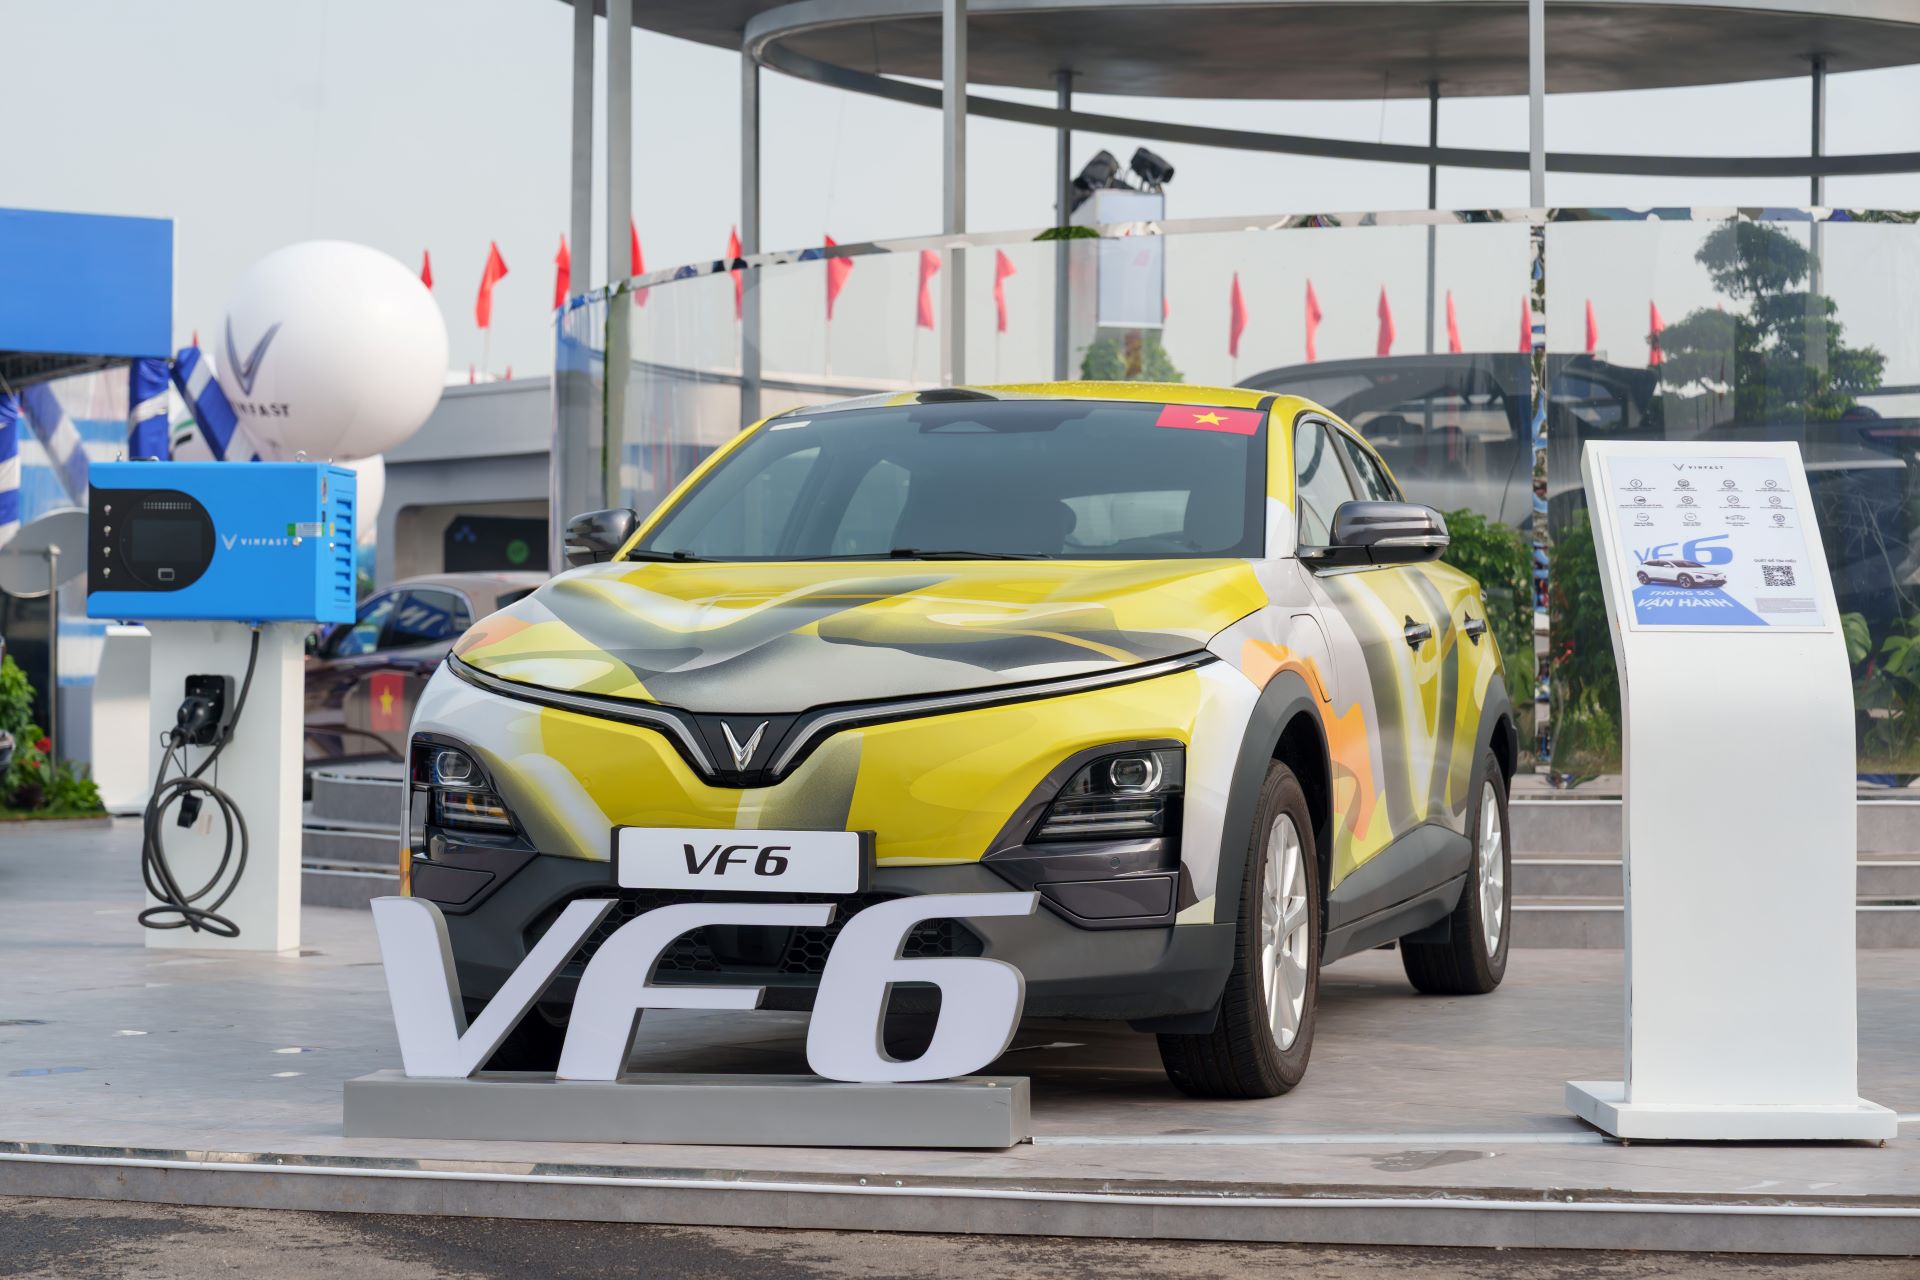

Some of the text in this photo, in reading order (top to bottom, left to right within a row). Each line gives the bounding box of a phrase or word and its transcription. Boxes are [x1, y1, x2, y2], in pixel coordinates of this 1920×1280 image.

[240, 537, 289, 546] VINFAST
[1637, 597, 1674, 610] VẬN
[683, 843, 791, 876] VF6
[370, 891, 1041, 1083] VF6
